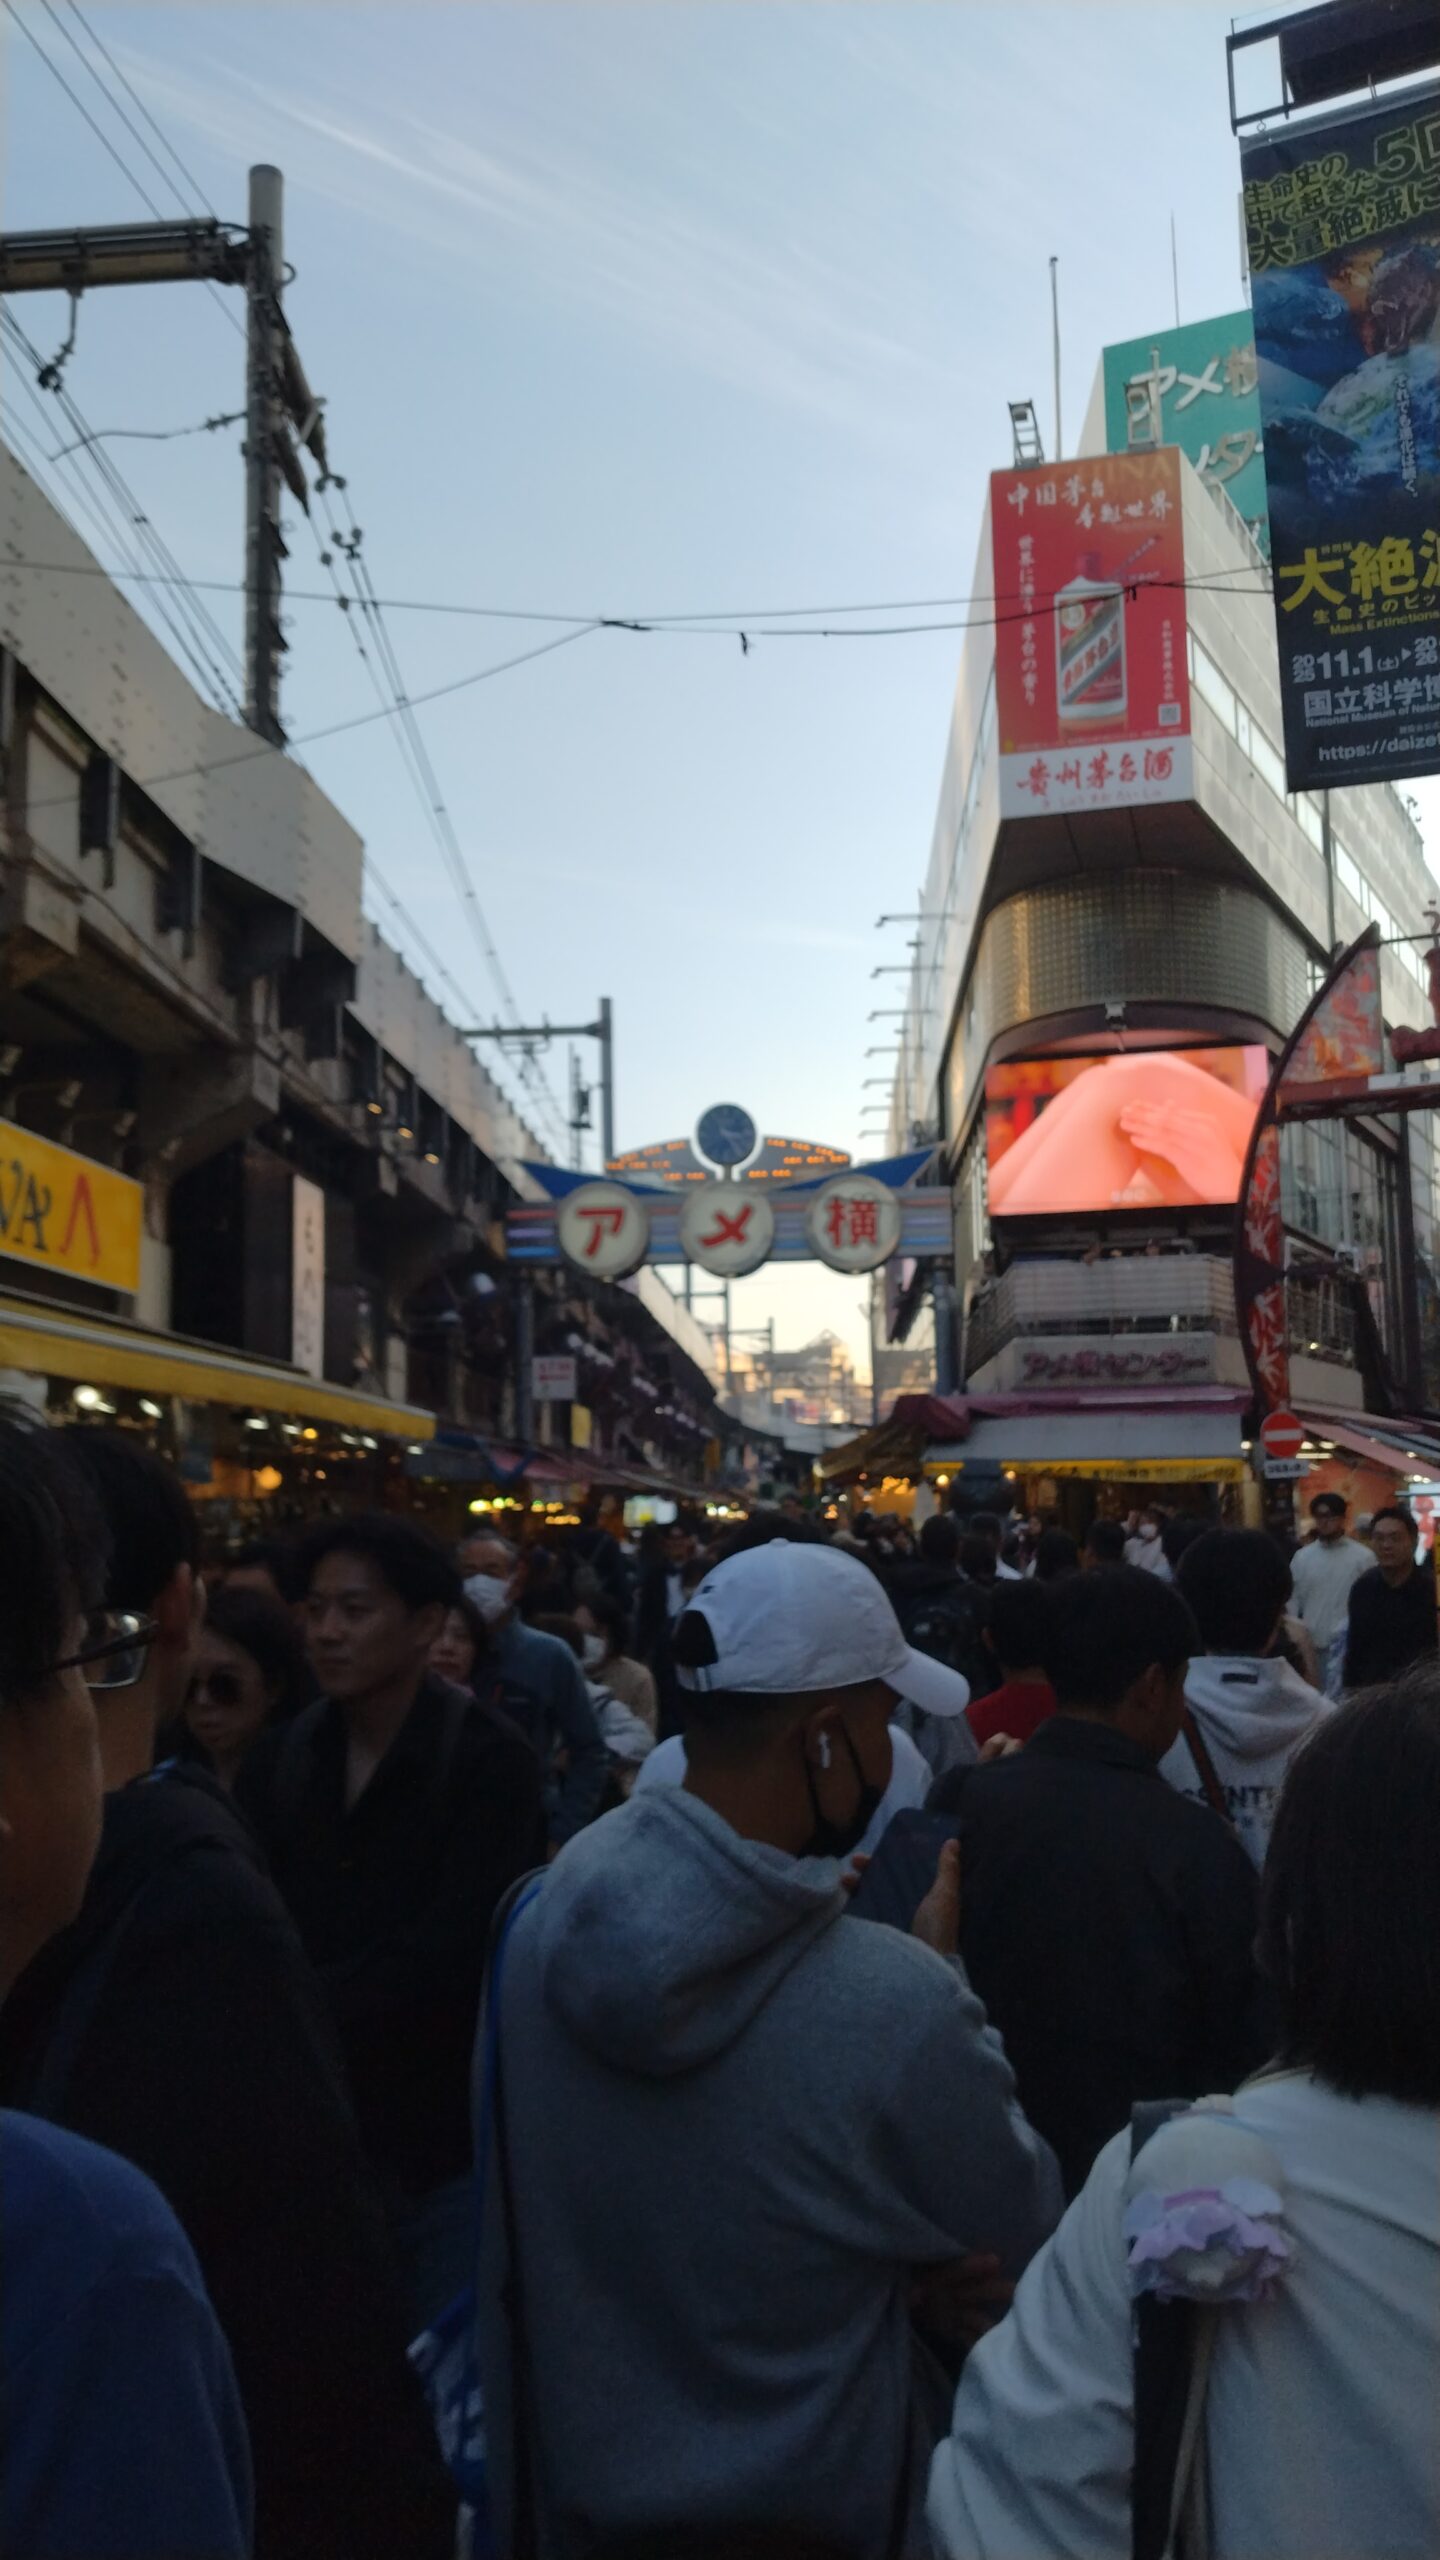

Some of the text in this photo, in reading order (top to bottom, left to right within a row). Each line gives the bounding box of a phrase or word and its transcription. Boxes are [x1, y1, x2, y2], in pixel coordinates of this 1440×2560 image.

[1305, 714, 1350, 728] National
[1351, 708, 1397, 722] Museum
[576, 1194, 880, 1258] アメ横
